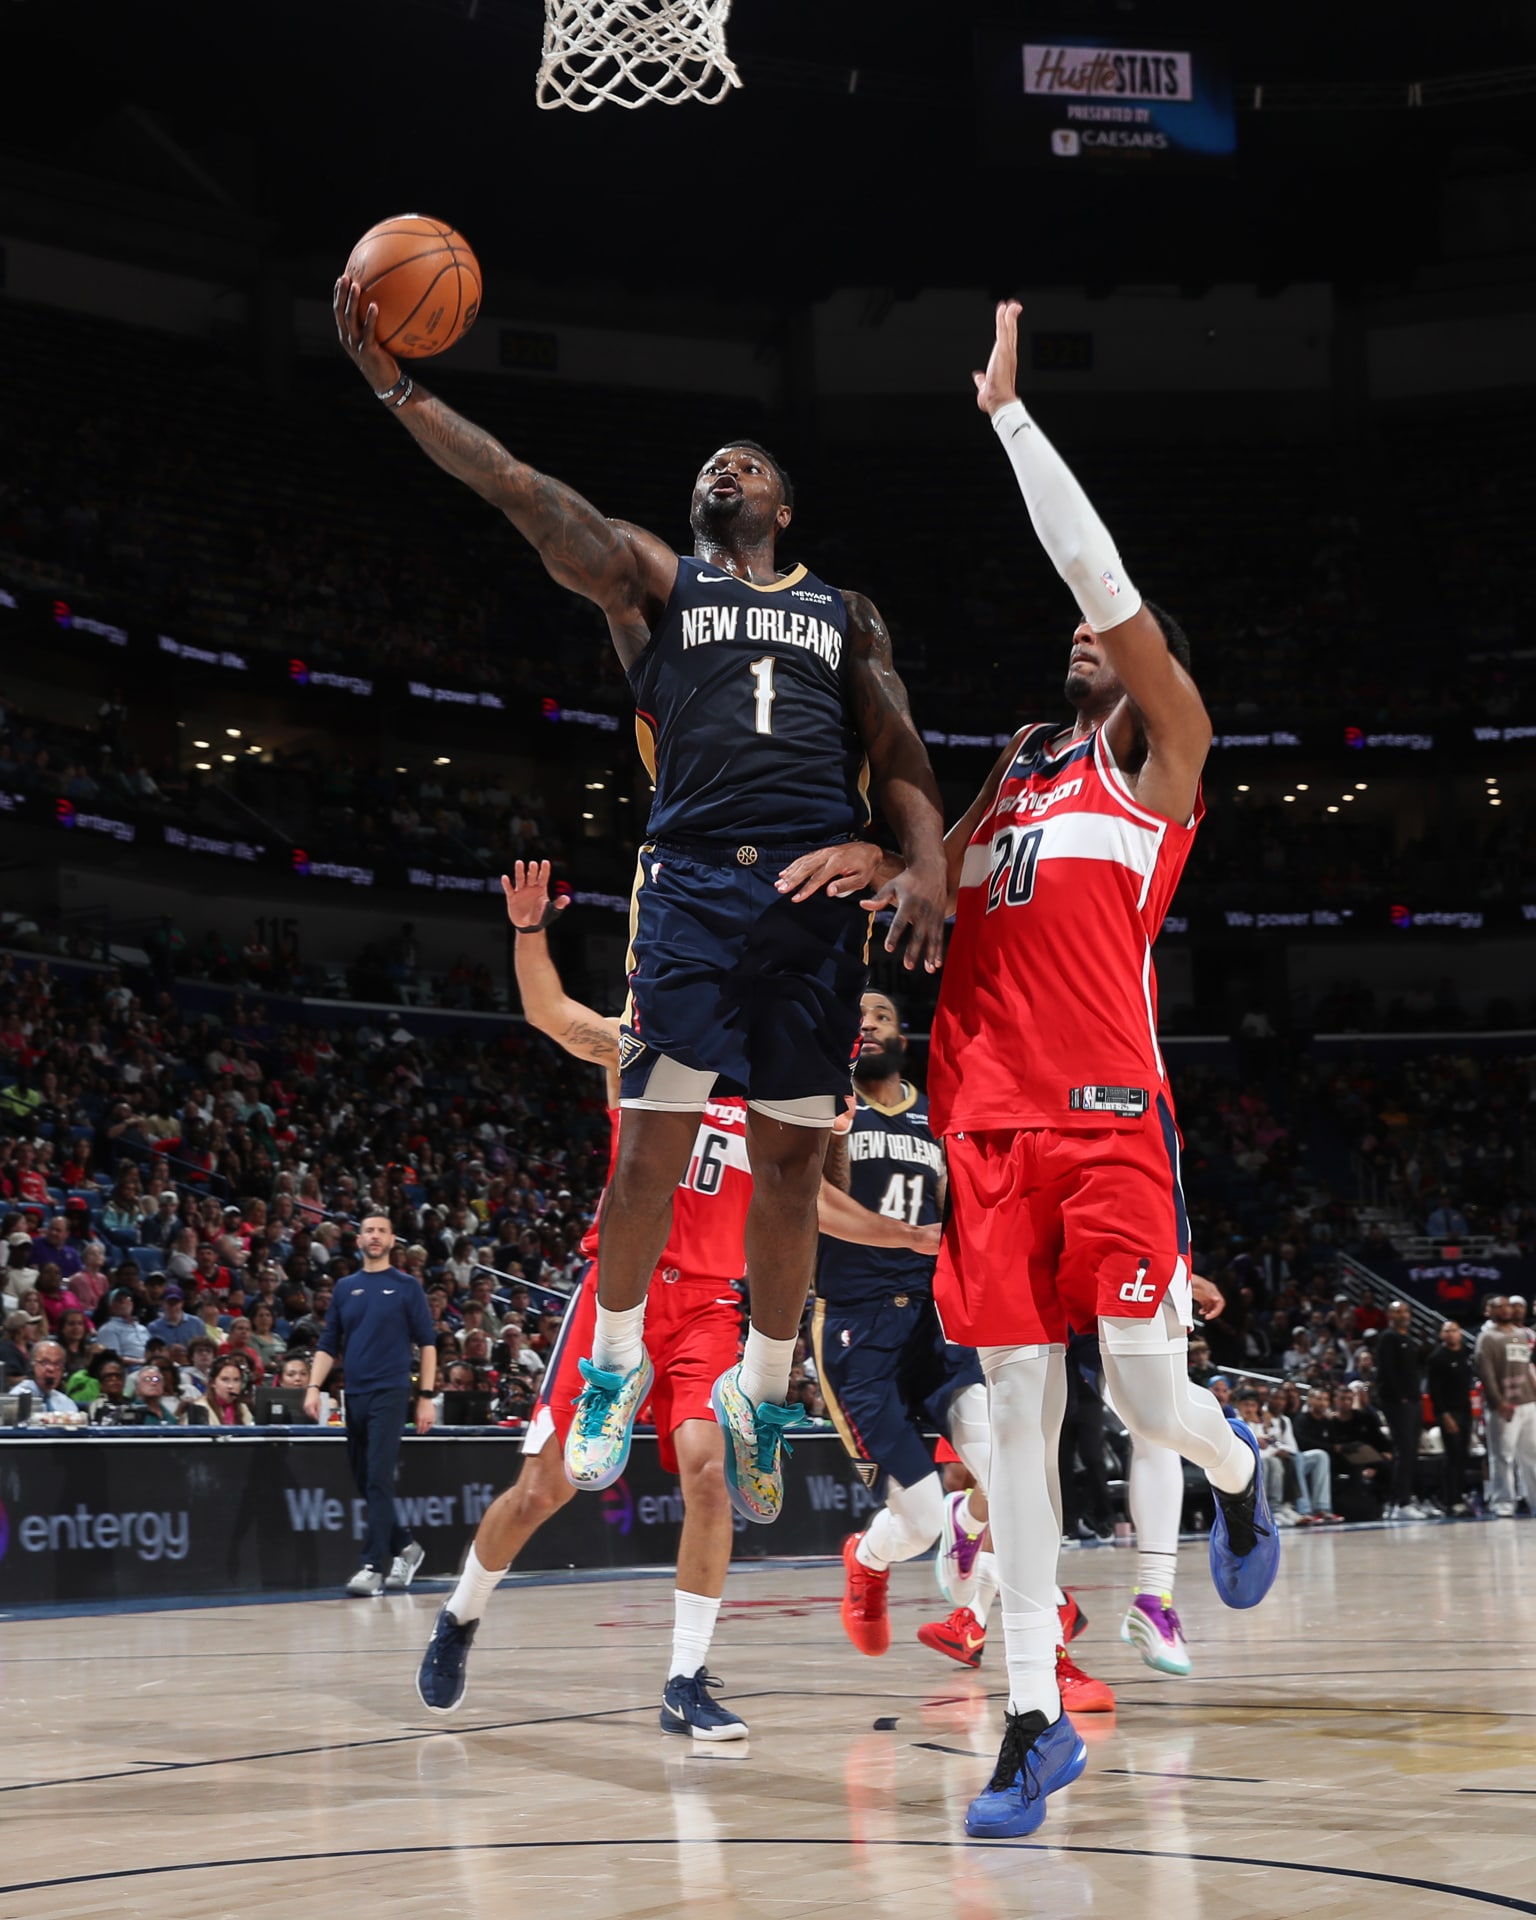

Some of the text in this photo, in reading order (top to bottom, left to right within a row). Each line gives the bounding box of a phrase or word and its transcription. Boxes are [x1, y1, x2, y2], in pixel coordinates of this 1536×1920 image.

[1067, 104, 1150, 123] PRESENTED BY
[1080, 129, 1168, 149] CAESARS
[791, 590, 832, 602] NEWAGE
[681, 606, 843, 671] NEW ORLEANS
[750, 655, 776, 735] 1
[1366, 732, 1433, 750] entergy
[985, 826, 1044, 912] 20
[1412, 911, 1483, 928] entergy
[848, 1130, 886, 1161] NEW
[880, 1173, 924, 1227] 41
[805, 1475, 848, 1511] We
[284, 1482, 495, 1541] We pwer lif
[18, 1503, 190, 1560] entergy
